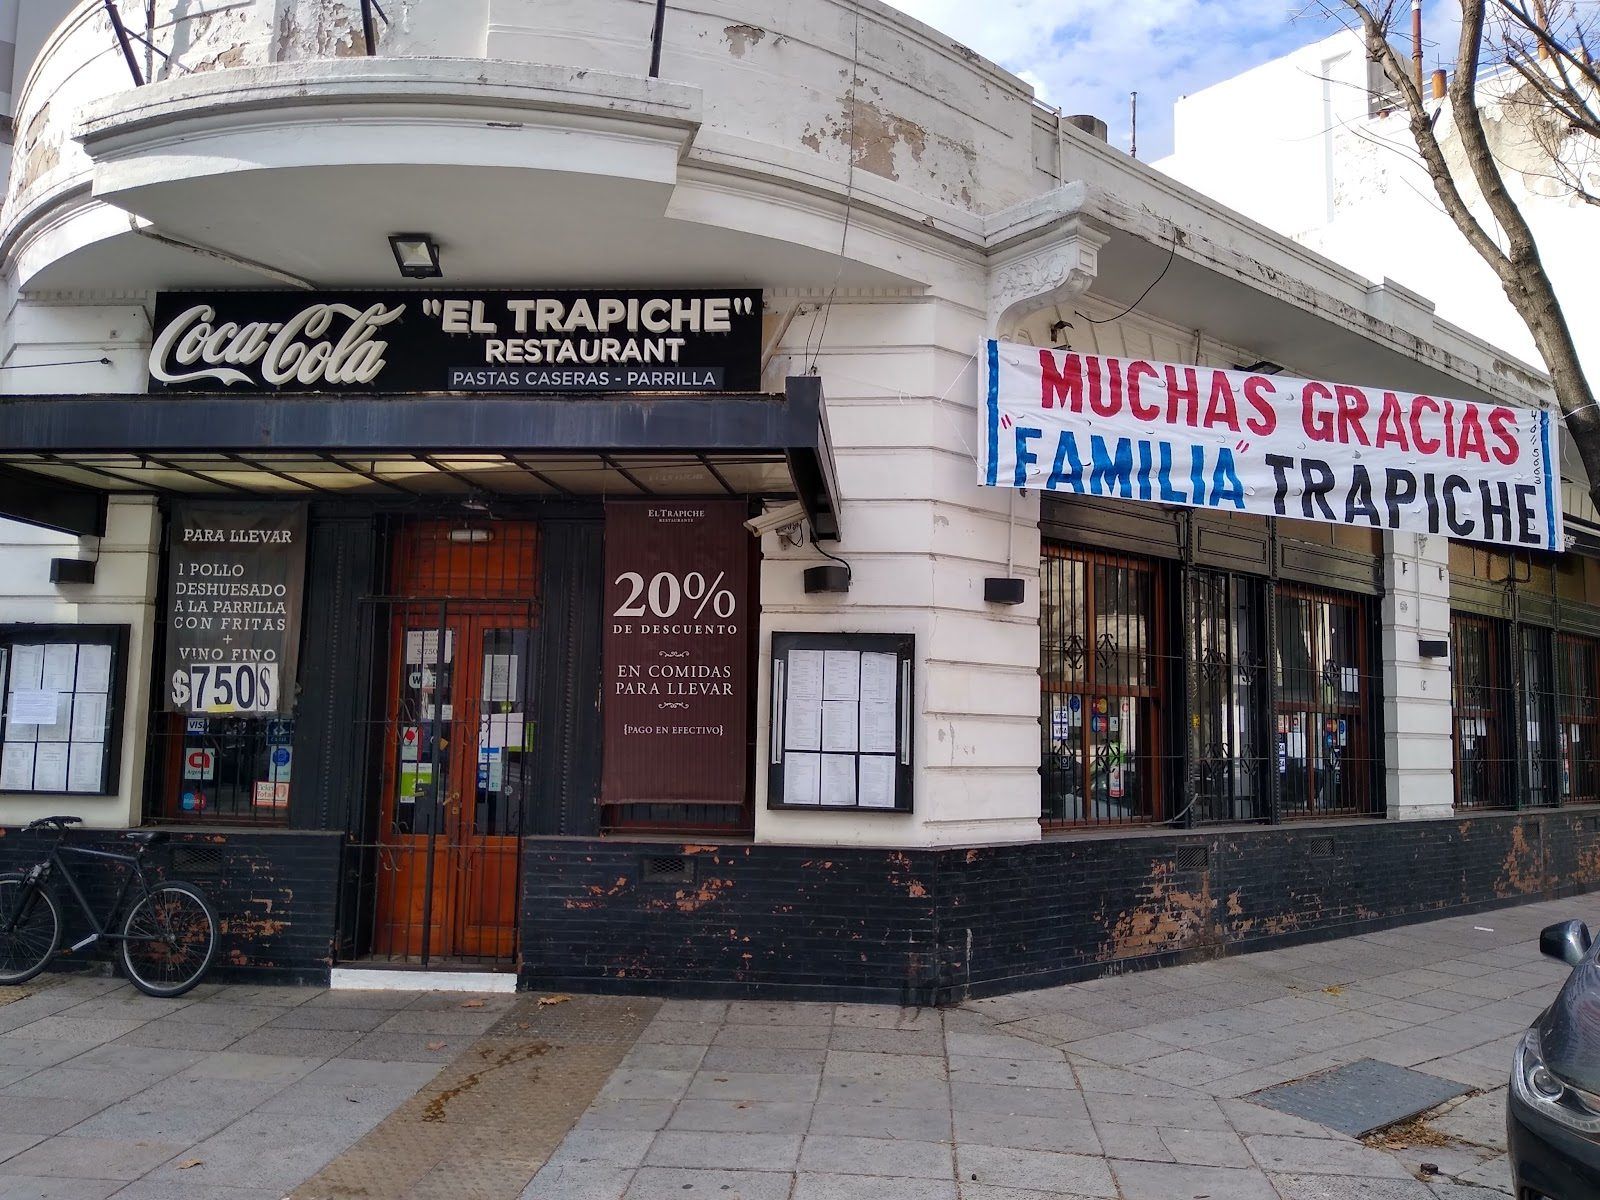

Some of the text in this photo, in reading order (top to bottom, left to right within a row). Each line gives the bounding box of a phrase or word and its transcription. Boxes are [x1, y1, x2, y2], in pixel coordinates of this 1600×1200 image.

[422, 297, 754, 335] "EL TRAPICHE"
[148, 303, 406, 387] Coca-Cola
[484, 338, 685, 364] RESTAURANT
[453, 371, 519, 386] PASTAS
[525, 371, 611, 387] CASERAS
[627, 371, 716, 387] PARRILLA
[1039, 349, 1521, 466] MUCHAS GRACIAS
[1265, 452, 1543, 544] TRAPICHE
[183, 528, 292, 543] PARA LLEVAR
[179, 563, 244, 576] 1 POLLO
[176, 582, 286, 597] DESHUESADO
[612, 571, 736, 619] 20%
[175, 600, 286, 614] A LA PARRILLA
[174, 617, 286, 631] CON FRITAS
[613, 625, 737, 635] DE DESCUENTO
[179, 648, 276, 661] VINO FINO
[618, 665, 731, 678] EN COMIDAS
[616, 683, 734, 695] PARA LLEVAR
[656, 726, 669, 734] EN
